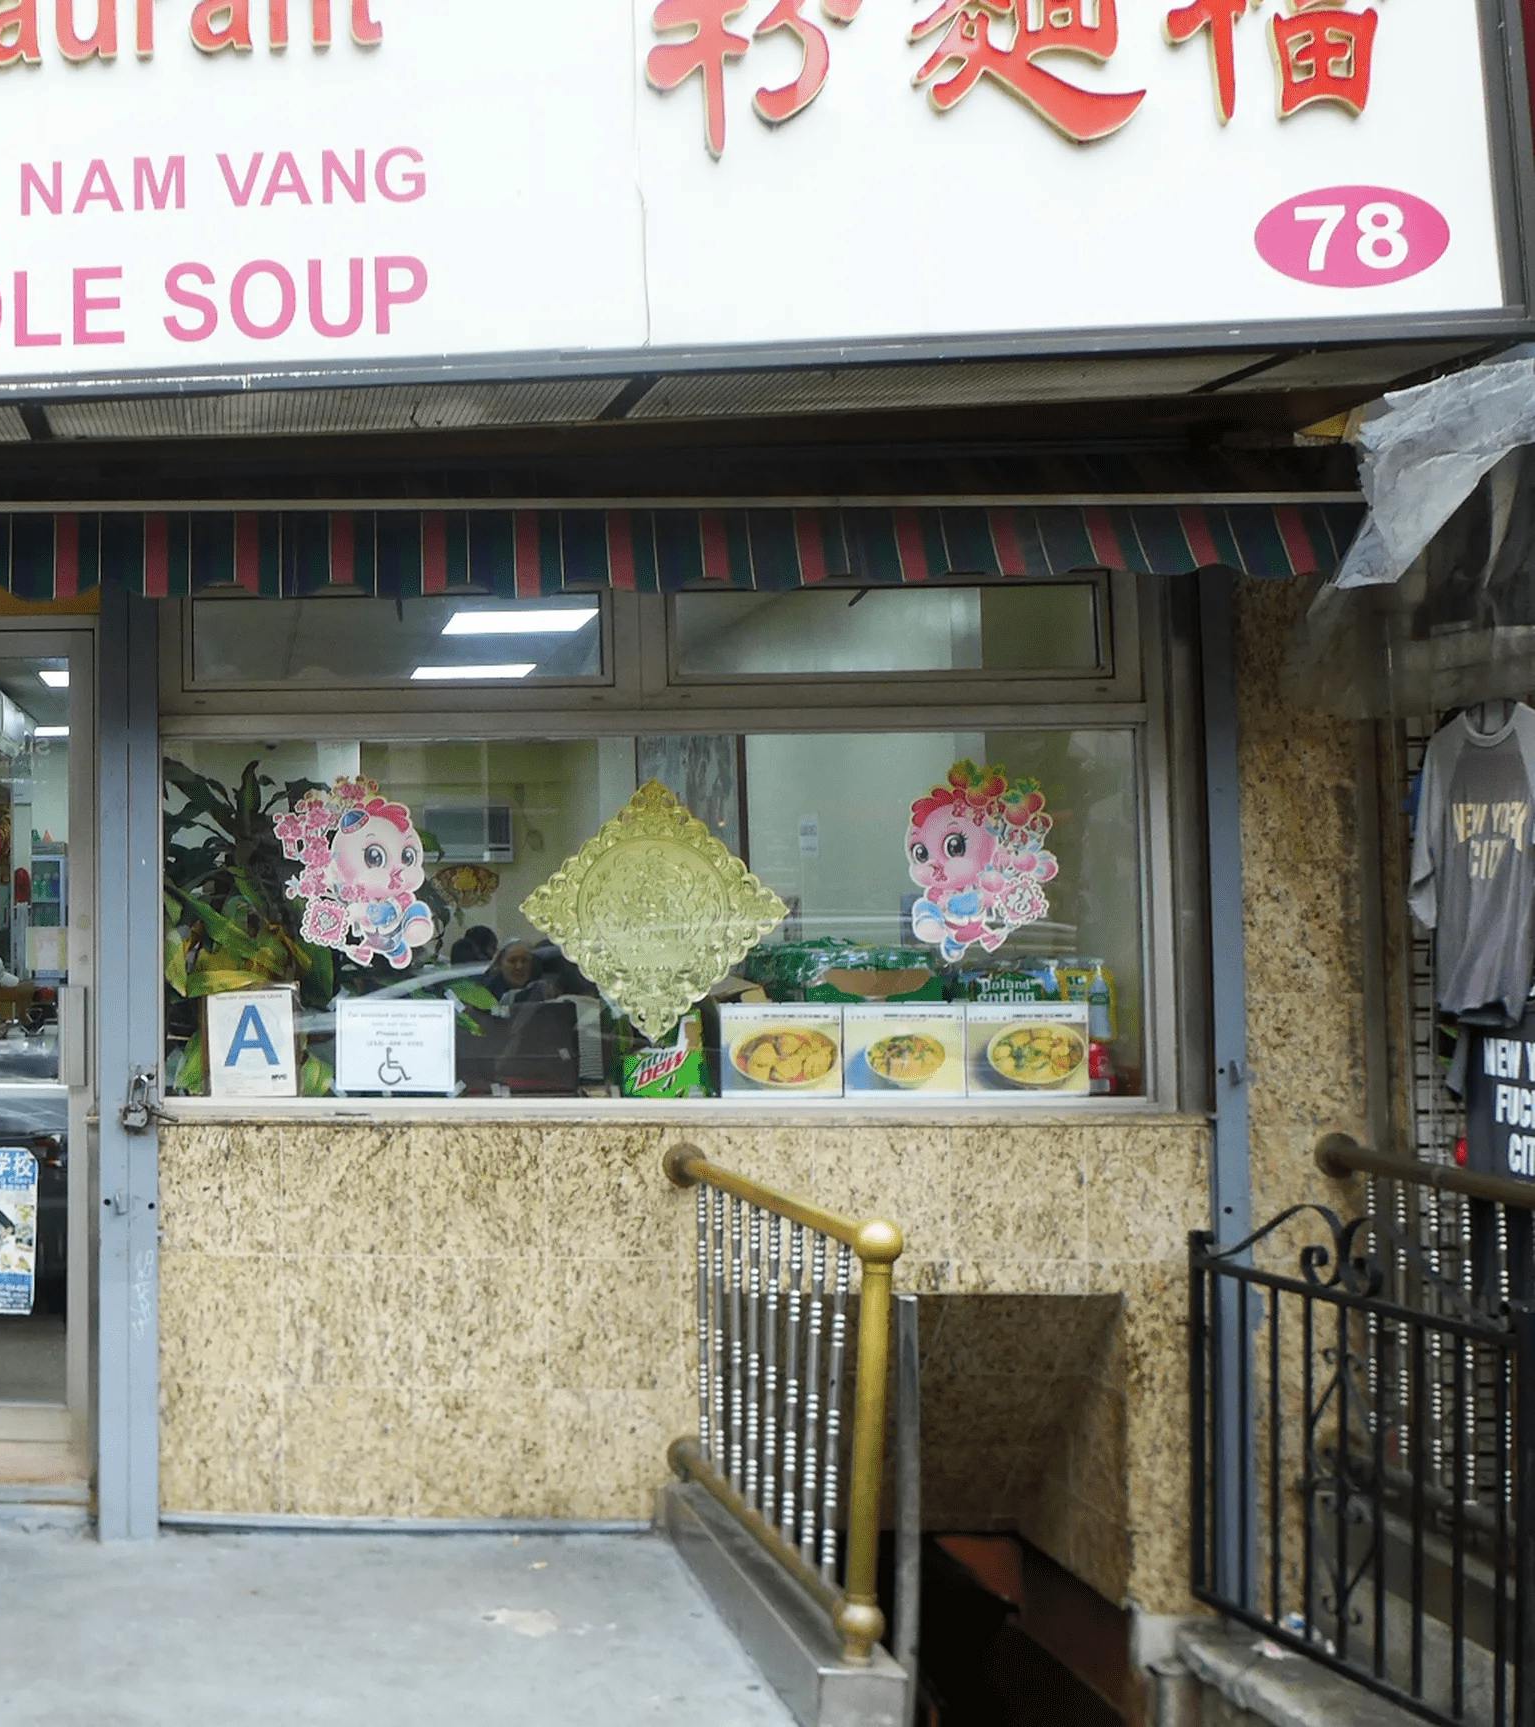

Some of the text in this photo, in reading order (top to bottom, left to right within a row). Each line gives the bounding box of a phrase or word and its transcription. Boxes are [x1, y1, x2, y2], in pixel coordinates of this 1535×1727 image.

[20, 155, 186, 215] NAM
[216, 146, 427, 207] VANG
[1293, 201, 1409, 272] 78
[163, 255, 428, 343] SOUP
[1452, 803, 1488, 843] NEW
[224, 1005, 281, 1067] A
[1483, 1037, 1522, 1079] NEW
